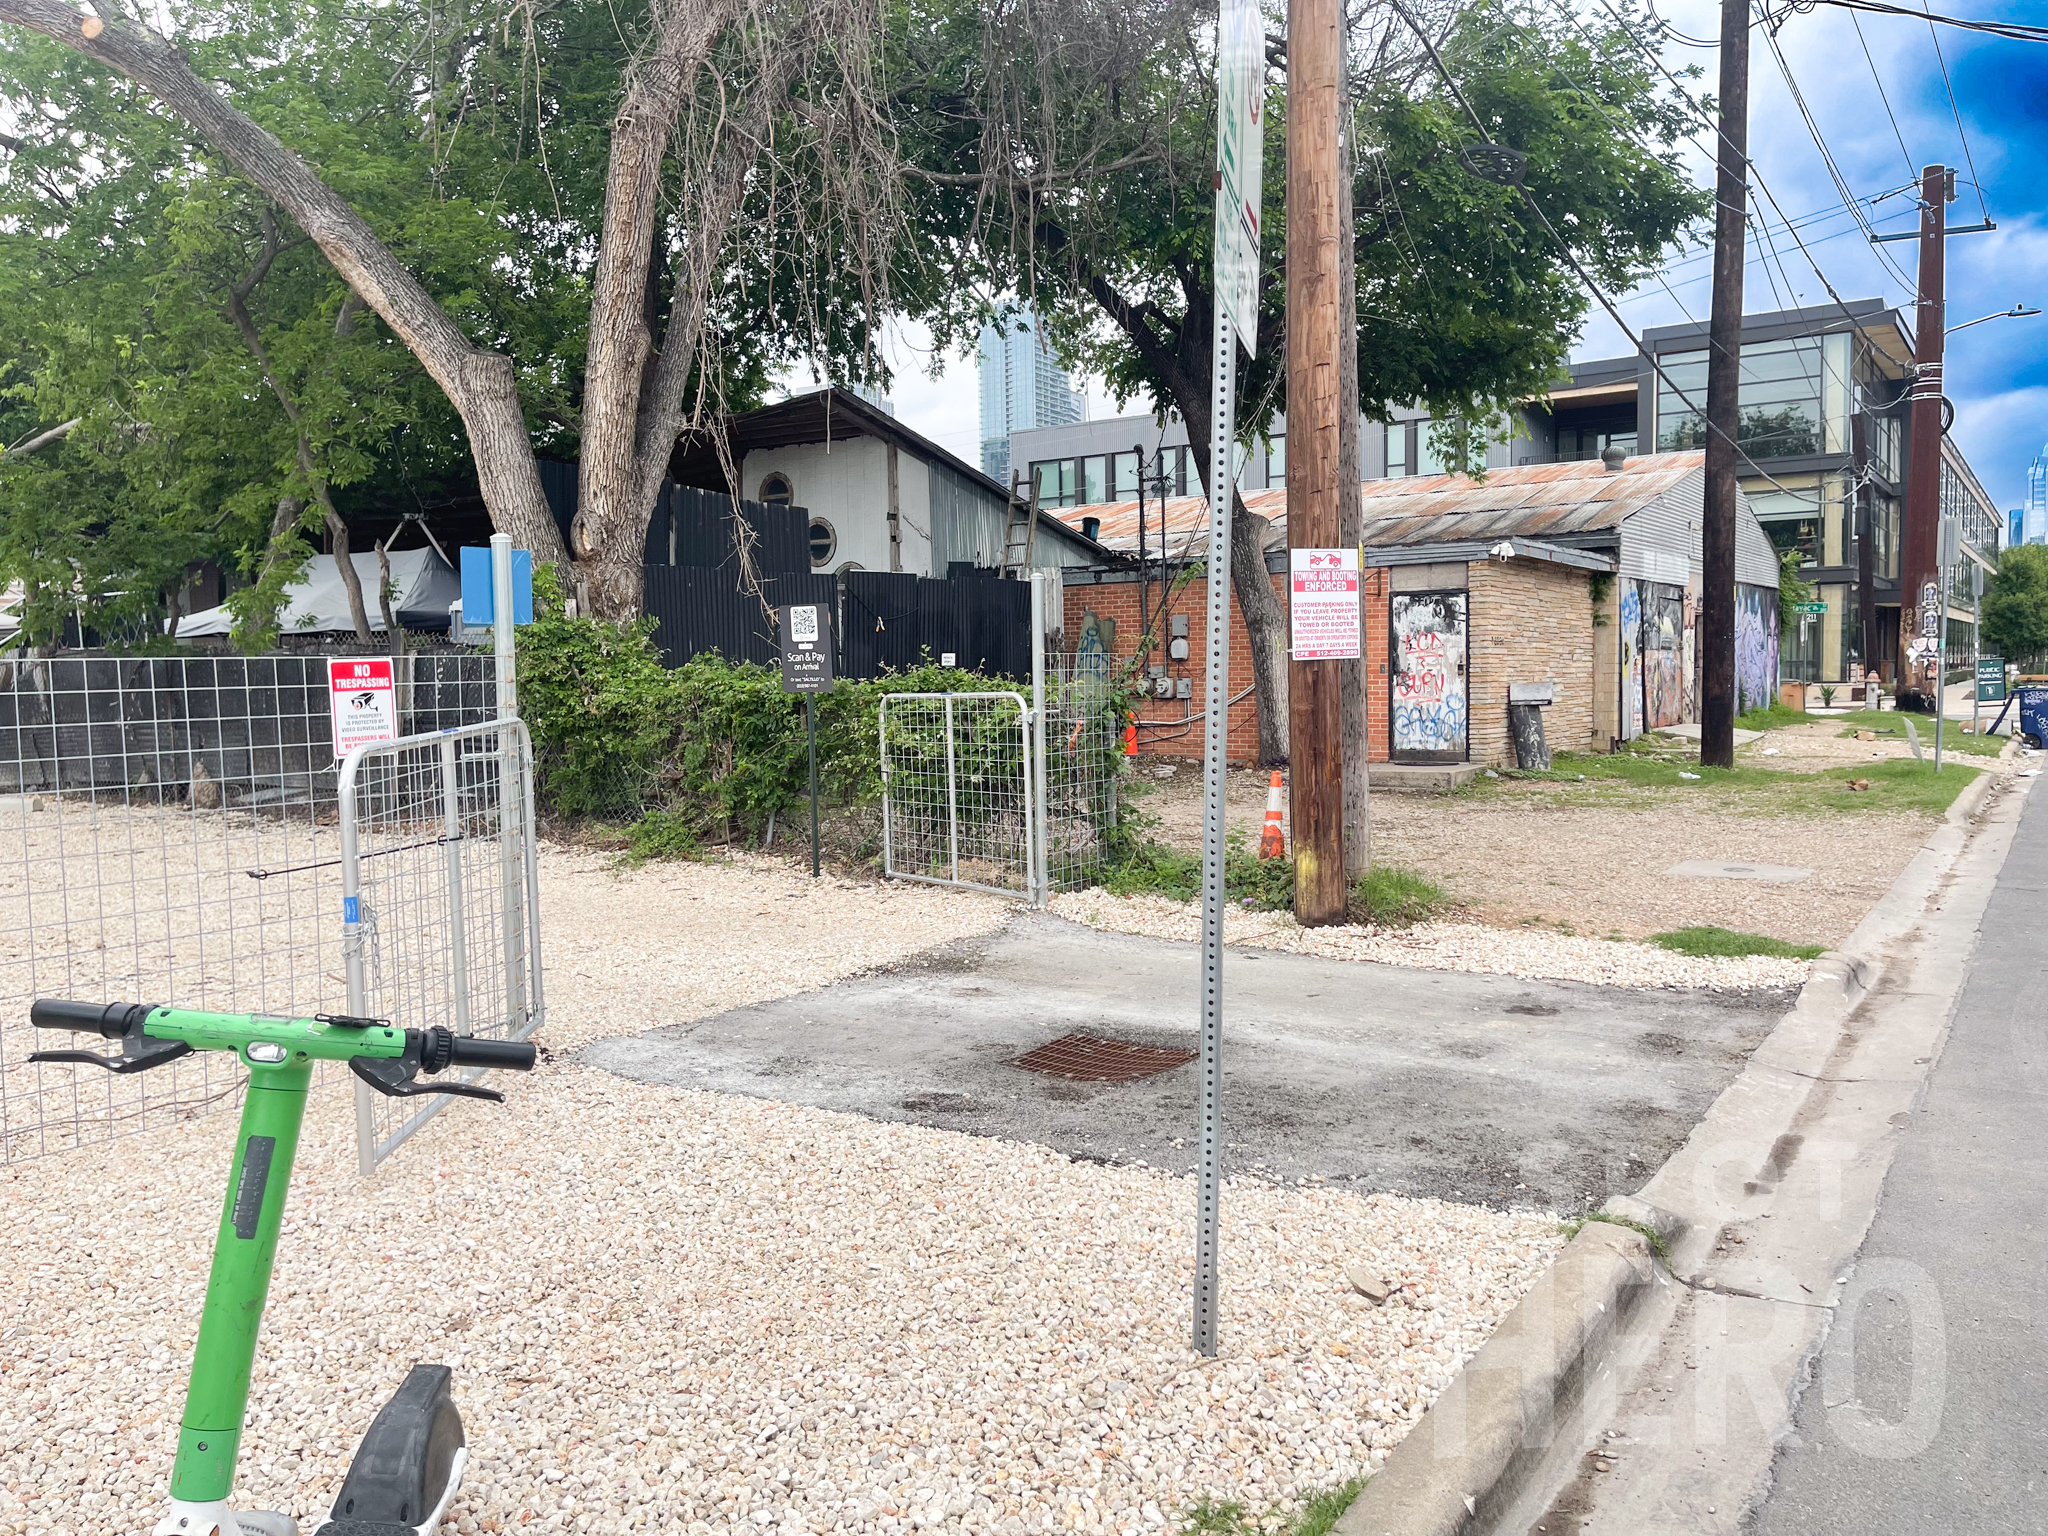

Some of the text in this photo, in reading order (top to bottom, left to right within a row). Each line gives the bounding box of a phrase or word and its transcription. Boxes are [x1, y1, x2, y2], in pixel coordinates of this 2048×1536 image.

[1295, 571, 1356, 581] TOWING AND BOOTING
[1305, 581, 1347, 591] ENFORCED
[787, 652, 825, 663] Scan & Pay
[354, 664, 370, 676] NO
[335, 677, 389, 689] TRESPASSING
